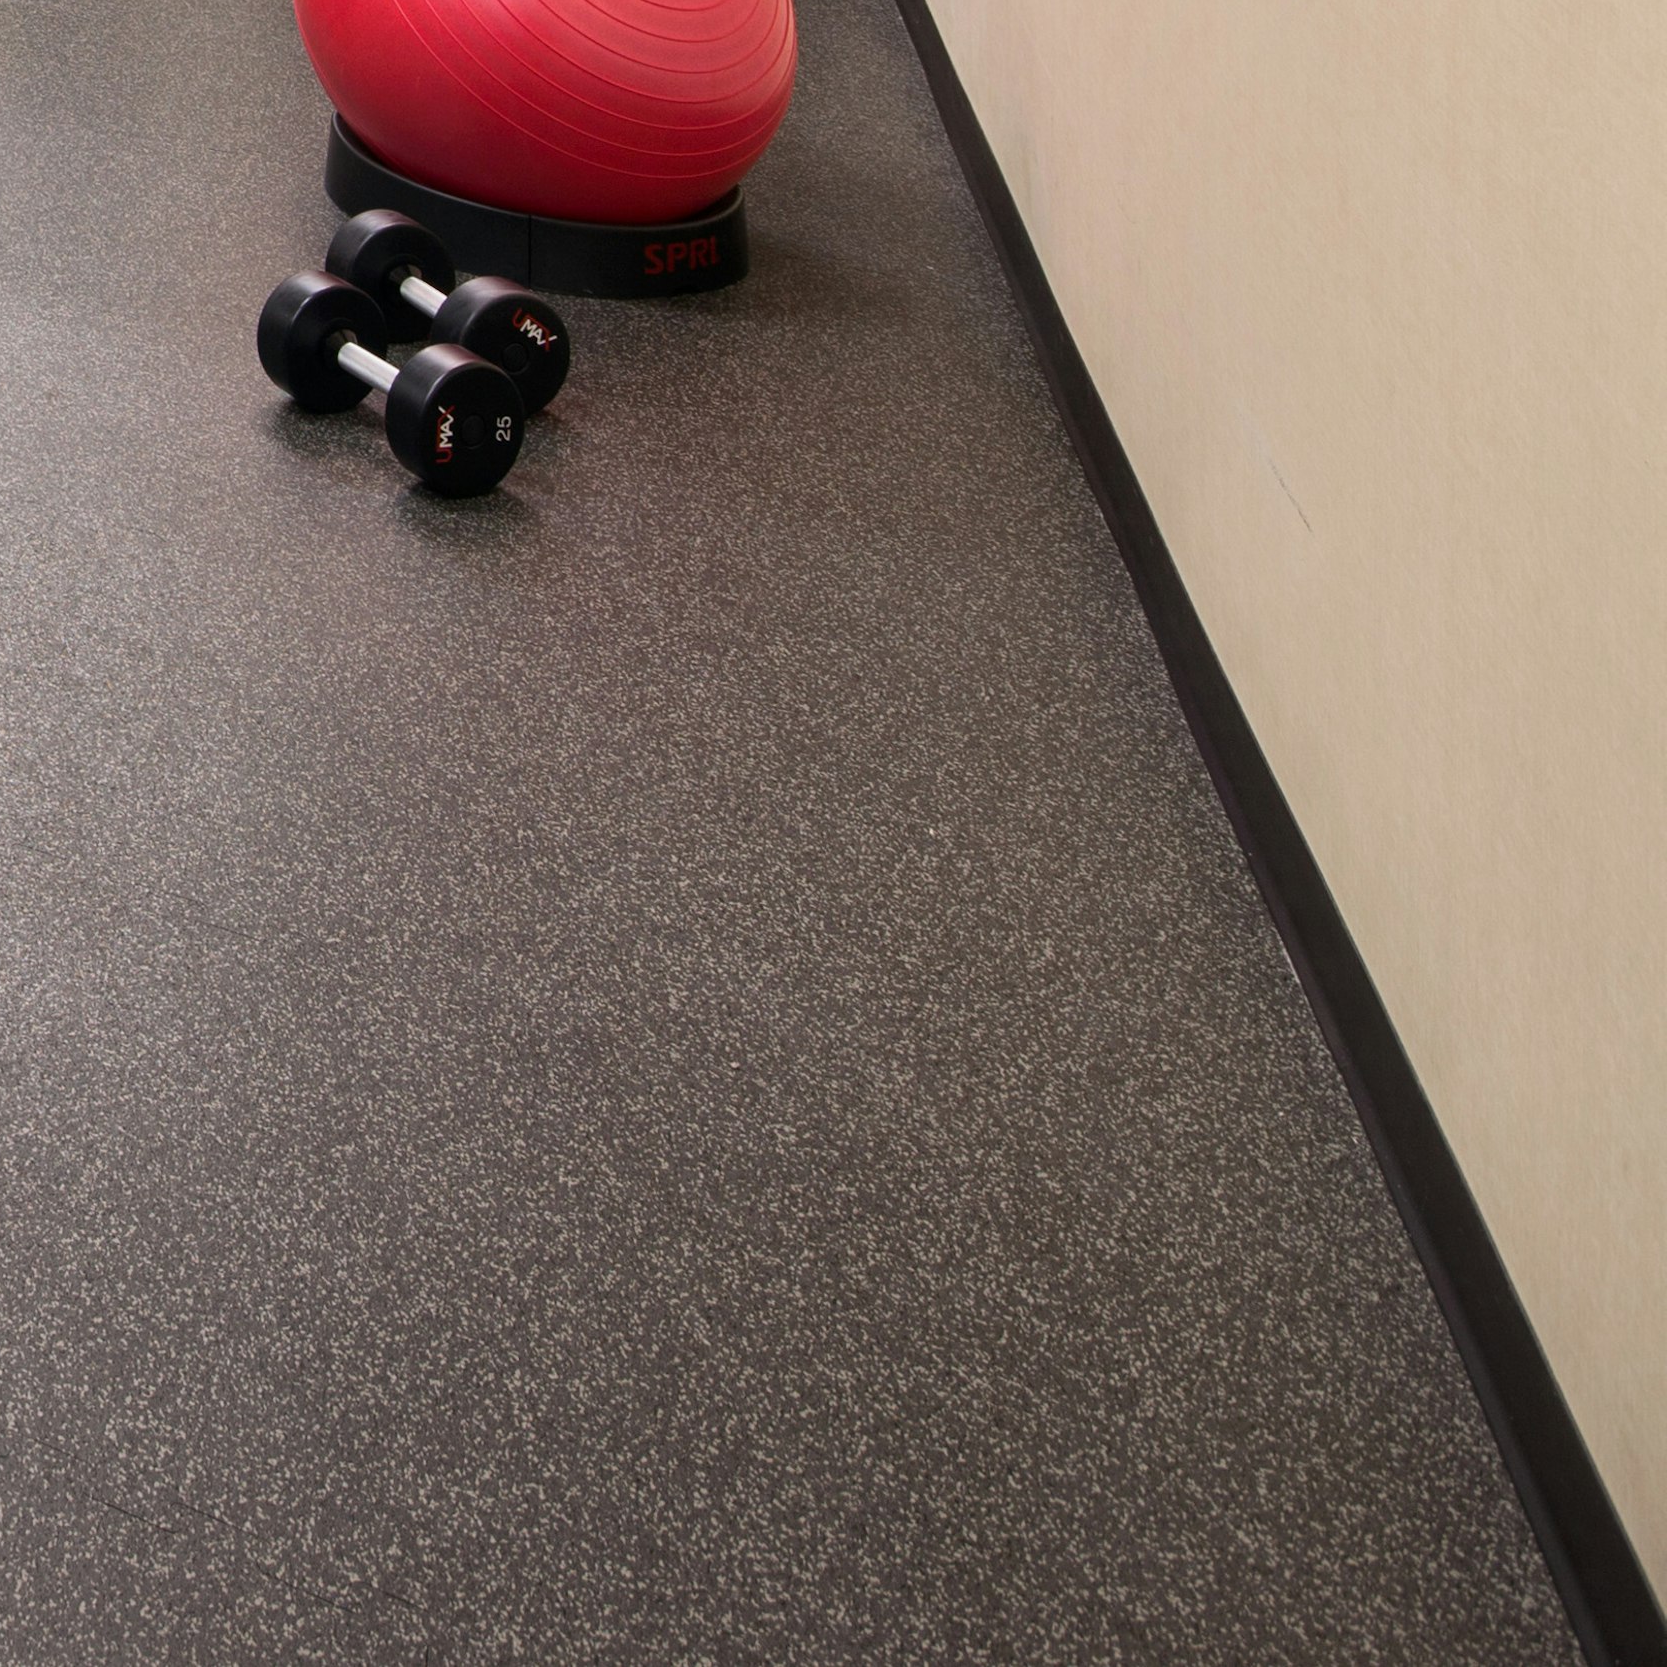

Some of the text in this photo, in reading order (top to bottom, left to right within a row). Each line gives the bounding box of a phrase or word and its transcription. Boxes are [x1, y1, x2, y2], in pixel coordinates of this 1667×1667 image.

[643, 236, 720, 276] SPRI
[511, 306, 558, 354] UMAX
[435, 403, 456, 464] UMAX
[495, 414, 513, 443] 25
